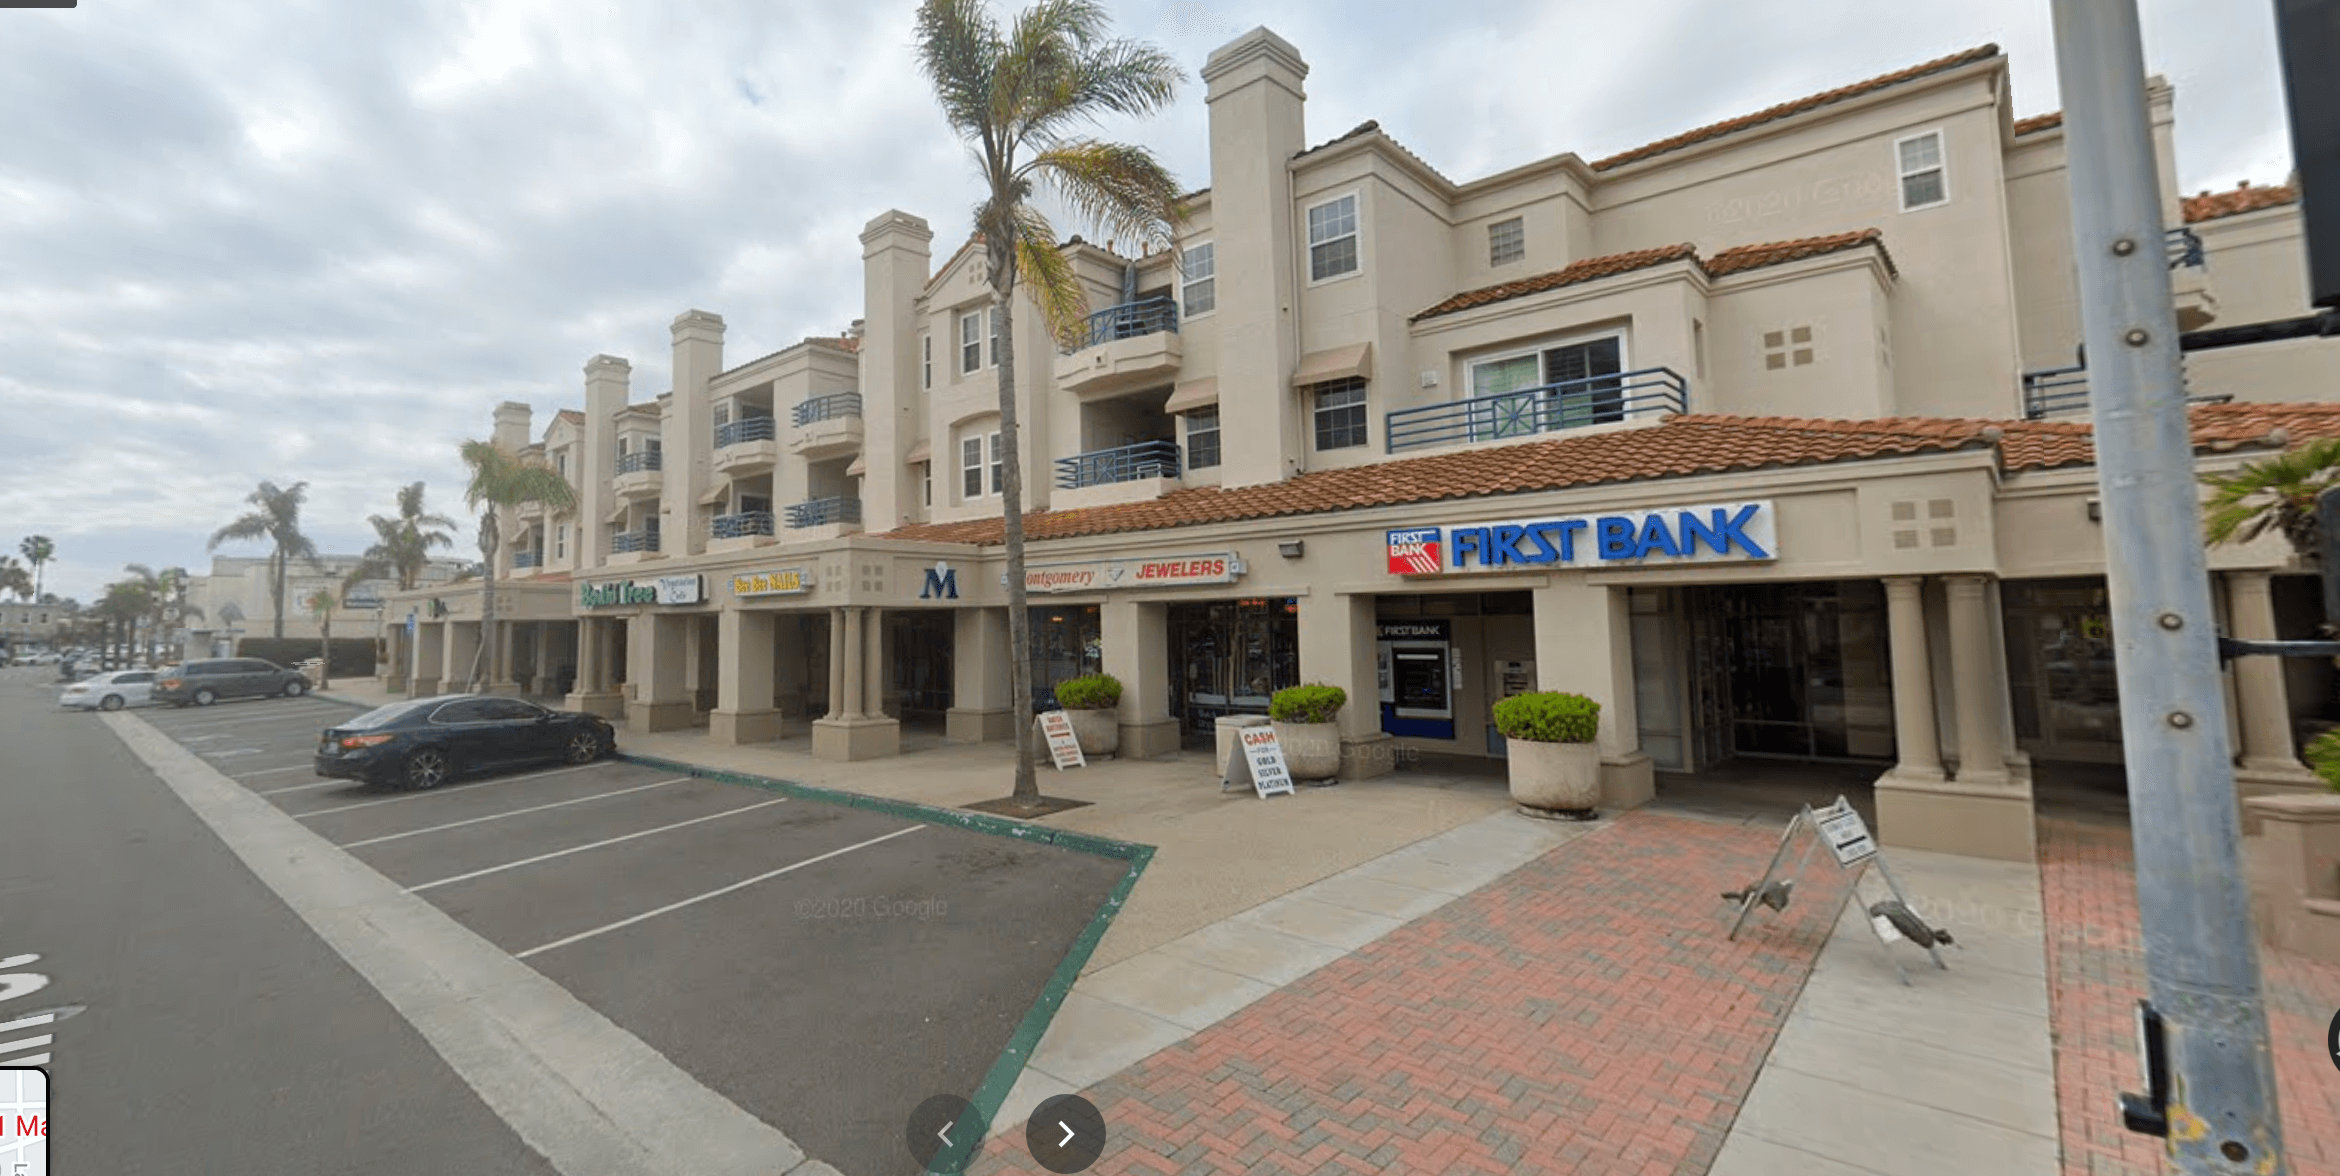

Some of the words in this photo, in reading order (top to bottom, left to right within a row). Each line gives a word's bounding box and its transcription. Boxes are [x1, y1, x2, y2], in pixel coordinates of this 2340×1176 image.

[1391, 528, 1437, 545] FIRST
[1450, 519, 1588, 568] FIRST
[1596, 504, 1770, 560] BANK
[1391, 543, 1428, 557] BANK
[1026, 569, 1095, 588] ontgomery
[1136, 559, 1225, 580] JEWELERS
[919, 565, 959, 599] M
[619, 580, 656, 604] Tree
[1385, 625, 1411, 635] FIRST
[1411, 625, 1440, 635] BANK
[1244, 731, 1276, 746] CASH
[1257, 746, 1269, 754] FOR
[1256, 755, 1277, 767] GOLD
[1257, 766, 1282, 778] SILVER
[1258, 777, 1290, 791] PLATINUM
